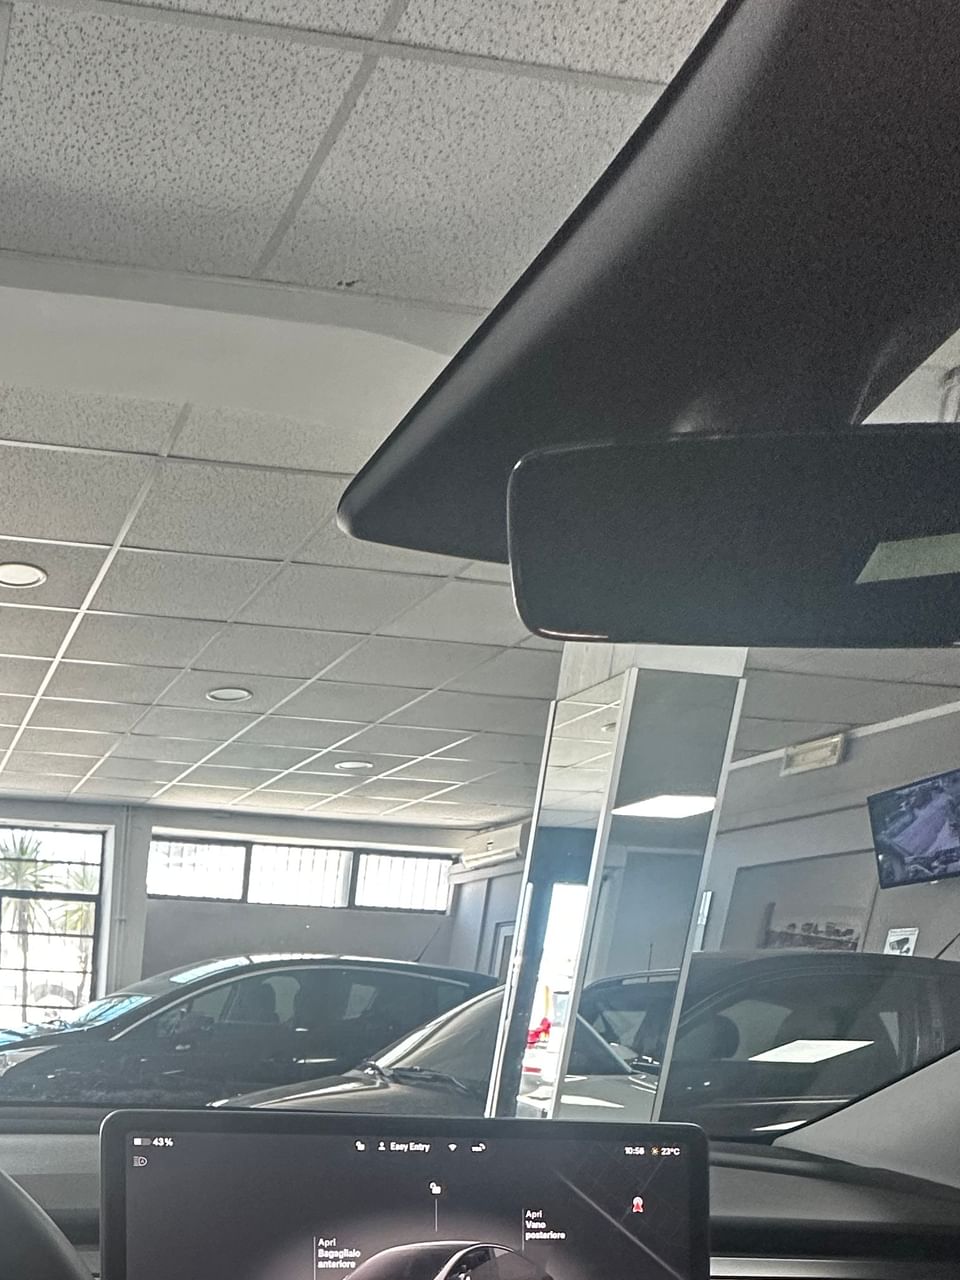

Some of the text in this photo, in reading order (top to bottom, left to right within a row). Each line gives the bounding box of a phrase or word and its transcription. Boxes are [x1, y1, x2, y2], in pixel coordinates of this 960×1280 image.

[390, 1142, 431, 1153] Easy Entry
[525, 1210, 543, 1220] Apri
[525, 1220, 547, 1229] Vano
[525, 1230, 566, 1241] posteriore
[318, 1238, 337, 1248] Apri
[318, 1248, 361, 1259] Bagagliaio
[318, 1260, 356, 1269] anteriore
